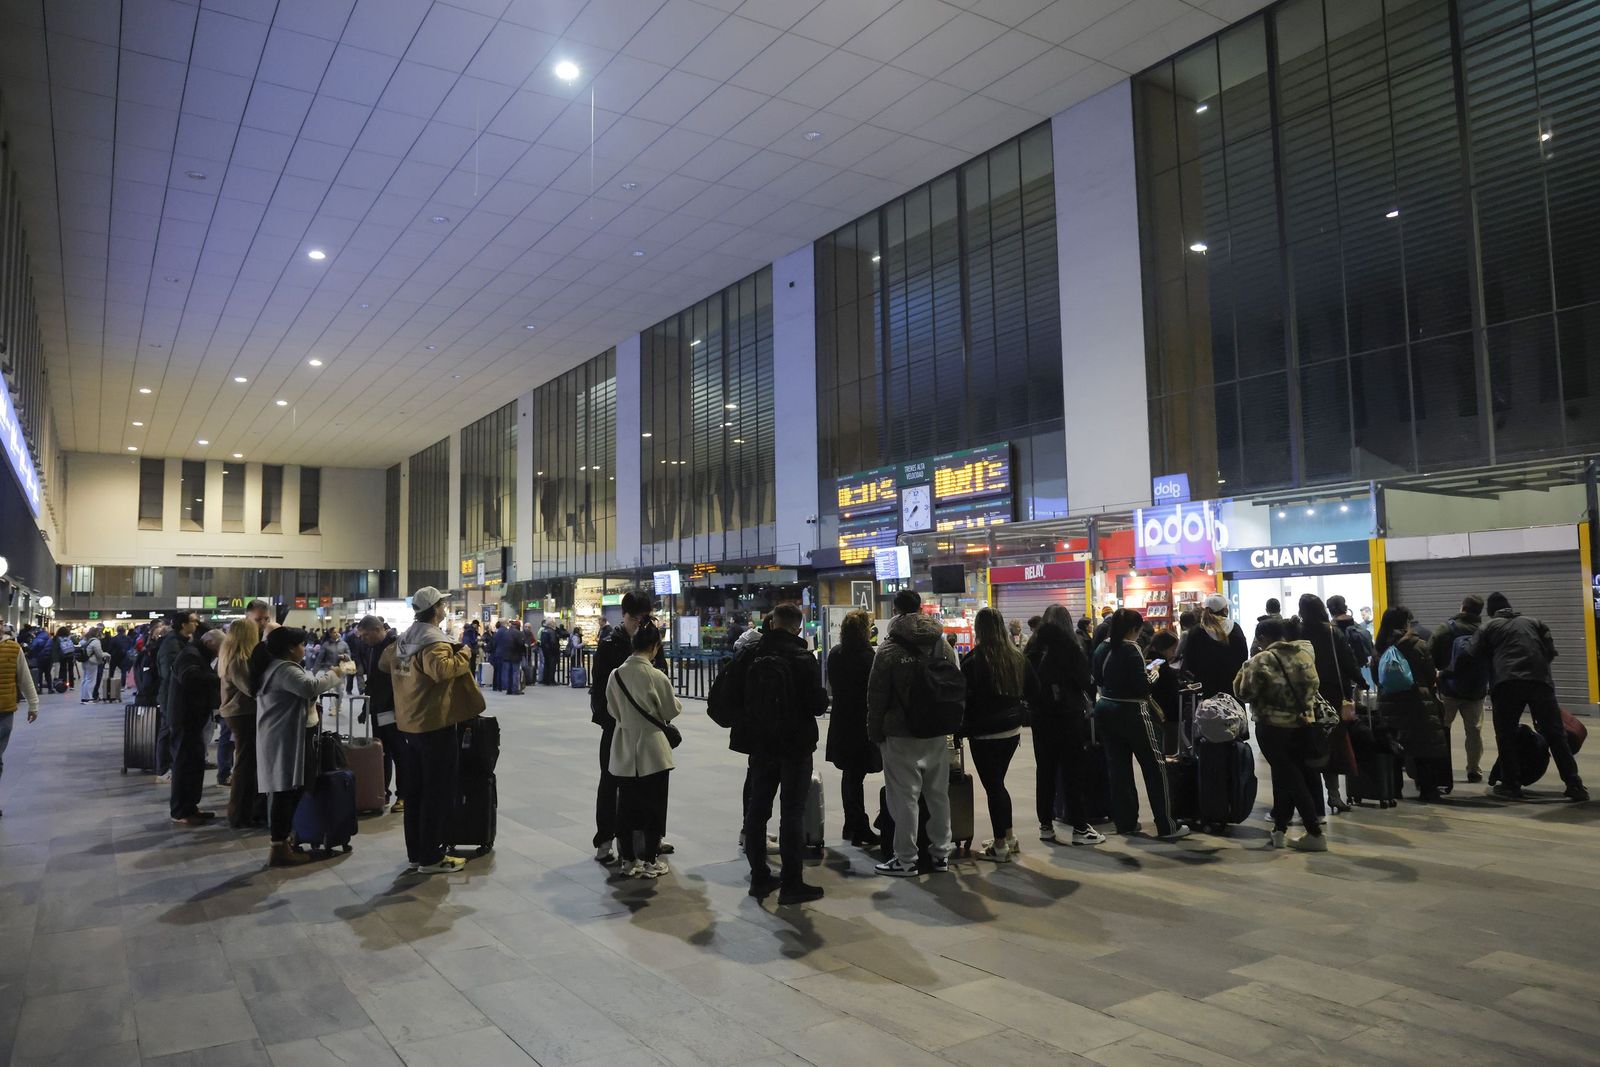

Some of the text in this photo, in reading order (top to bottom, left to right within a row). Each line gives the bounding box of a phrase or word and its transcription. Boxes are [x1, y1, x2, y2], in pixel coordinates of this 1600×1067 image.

[904, 464, 916, 472] TRENES
[906, 471, 924, 480] VELOCIDAD
[1250, 544, 1338, 568] CHANGE
[1024, 564, 1044, 580] RELAY
[861, 591, 869, 610] A
